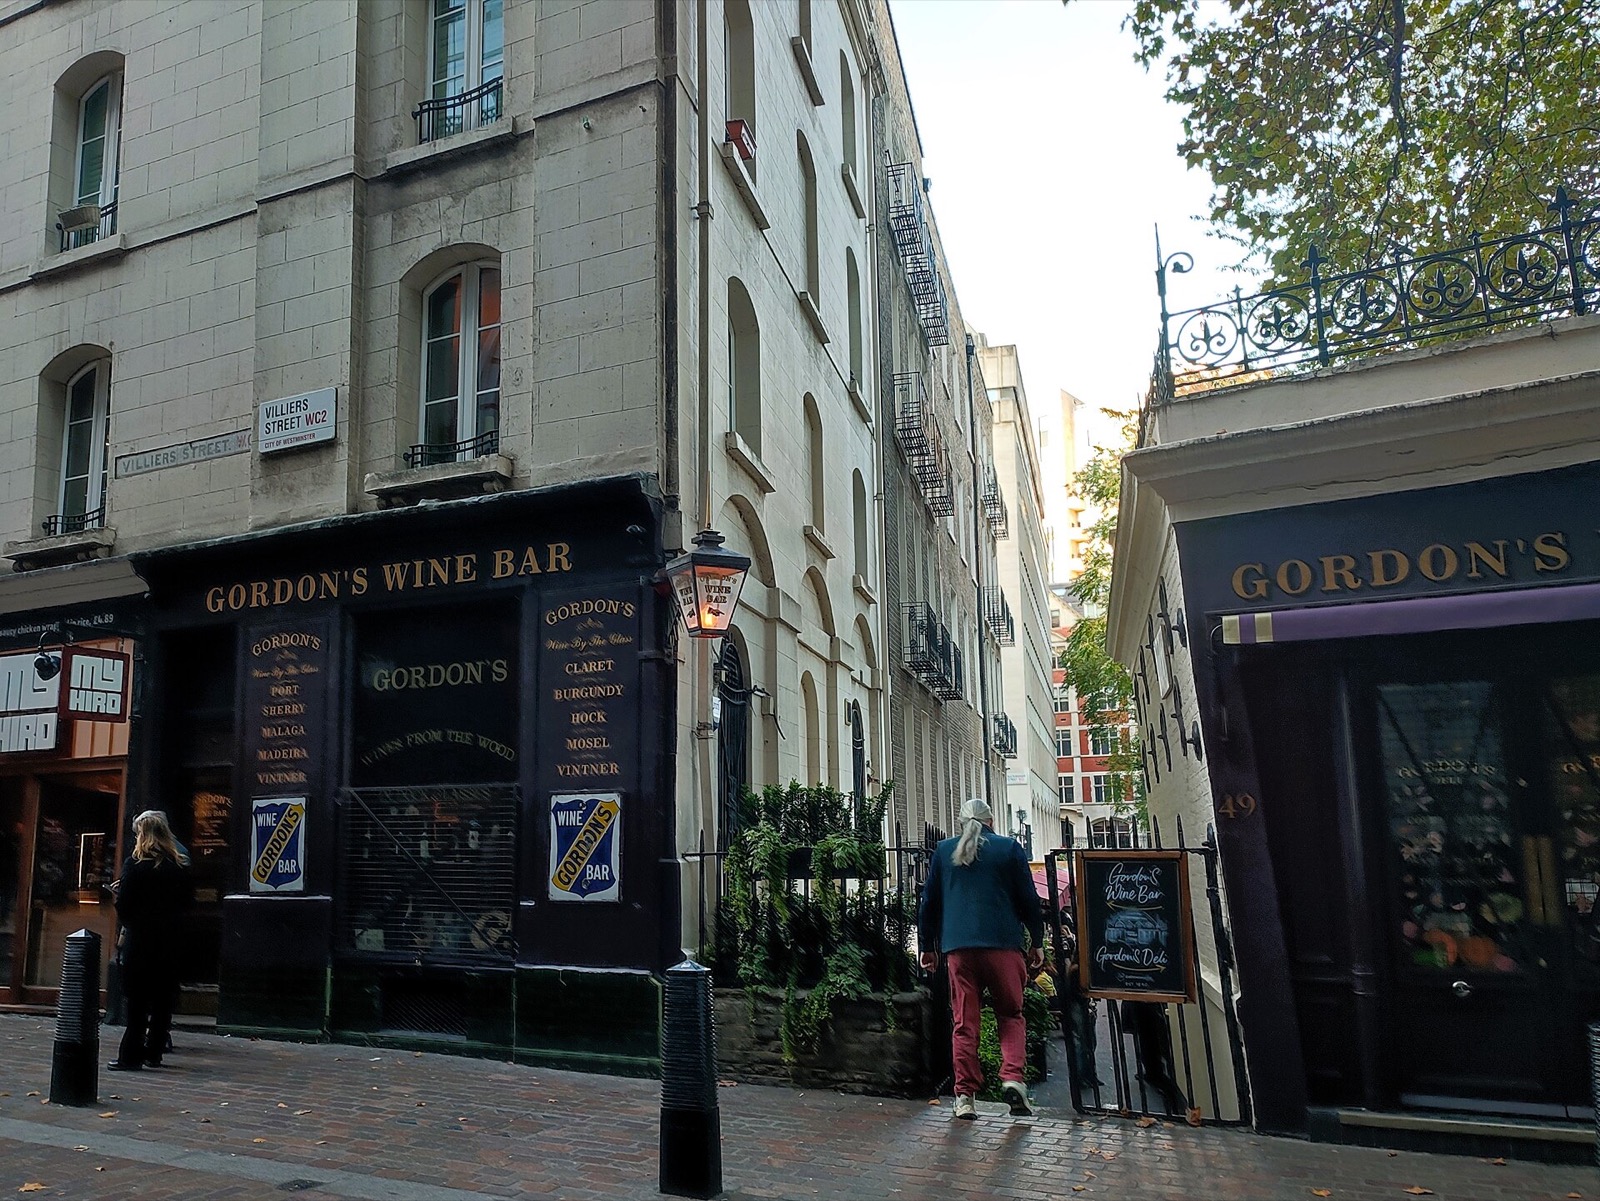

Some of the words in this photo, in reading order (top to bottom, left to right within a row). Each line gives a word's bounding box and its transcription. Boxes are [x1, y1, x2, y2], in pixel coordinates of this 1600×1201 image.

[265, 398, 309, 419] VILLIERS
[265, 416, 302, 435] STREET
[305, 410, 327, 426] WC2
[264, 441, 275, 449] CITY
[283, 433, 316, 445] WESTMINSTER
[122, 453, 177, 473] VILLIERS
[1231, 532, 1570, 600] GORDON'S
[206, 567, 368, 614] GORDON'S
[382, 553, 477, 592] WINE
[492, 542, 574, 579] BAR
[704, 585, 732, 594] WINE
[706, 594, 728, 604] BAR
[545, 599, 636, 625] GORDON'S
[17, 625, 41, 635] chicken
[252, 633, 321, 656] GORDON'S
[571, 636, 587, 651] By
[589, 634, 606, 646] The
[373, 659, 508, 691] GORDON'S
[565, 660, 615, 674] CLARET
[271, 684, 300, 697] PORT
[554, 684, 624, 700] BURGUNDY
[69, 689, 121, 714] HIRO
[262, 703, 308, 717] SHERRY
[571, 711, 608, 724] HOCK
[262, 725, 307, 738] MALAGA
[406, 729, 443, 747] FROM
[447, 729, 474, 745] THE
[477, 734, 516, 762] WOOD
[566, 737, 610, 750] MOSEL
[257, 748, 309, 760] MADEIRA
[556, 762, 620, 776] VINTNER
[257, 771, 307, 784] VINTNER
[1218, 793, 1256, 819] 49
[257, 812, 277, 827] WINE
[557, 810, 584, 826] WINE
[256, 808, 300, 879] GORDON'S
[557, 806, 613, 886] GORDON'S
[278, 859, 297, 874] BAR
[586, 864, 610, 880] BAR
[1105, 884, 1137, 901] Wine
[1137, 885, 1165, 903] Bar
[1142, 948, 1168, 966] Deli
